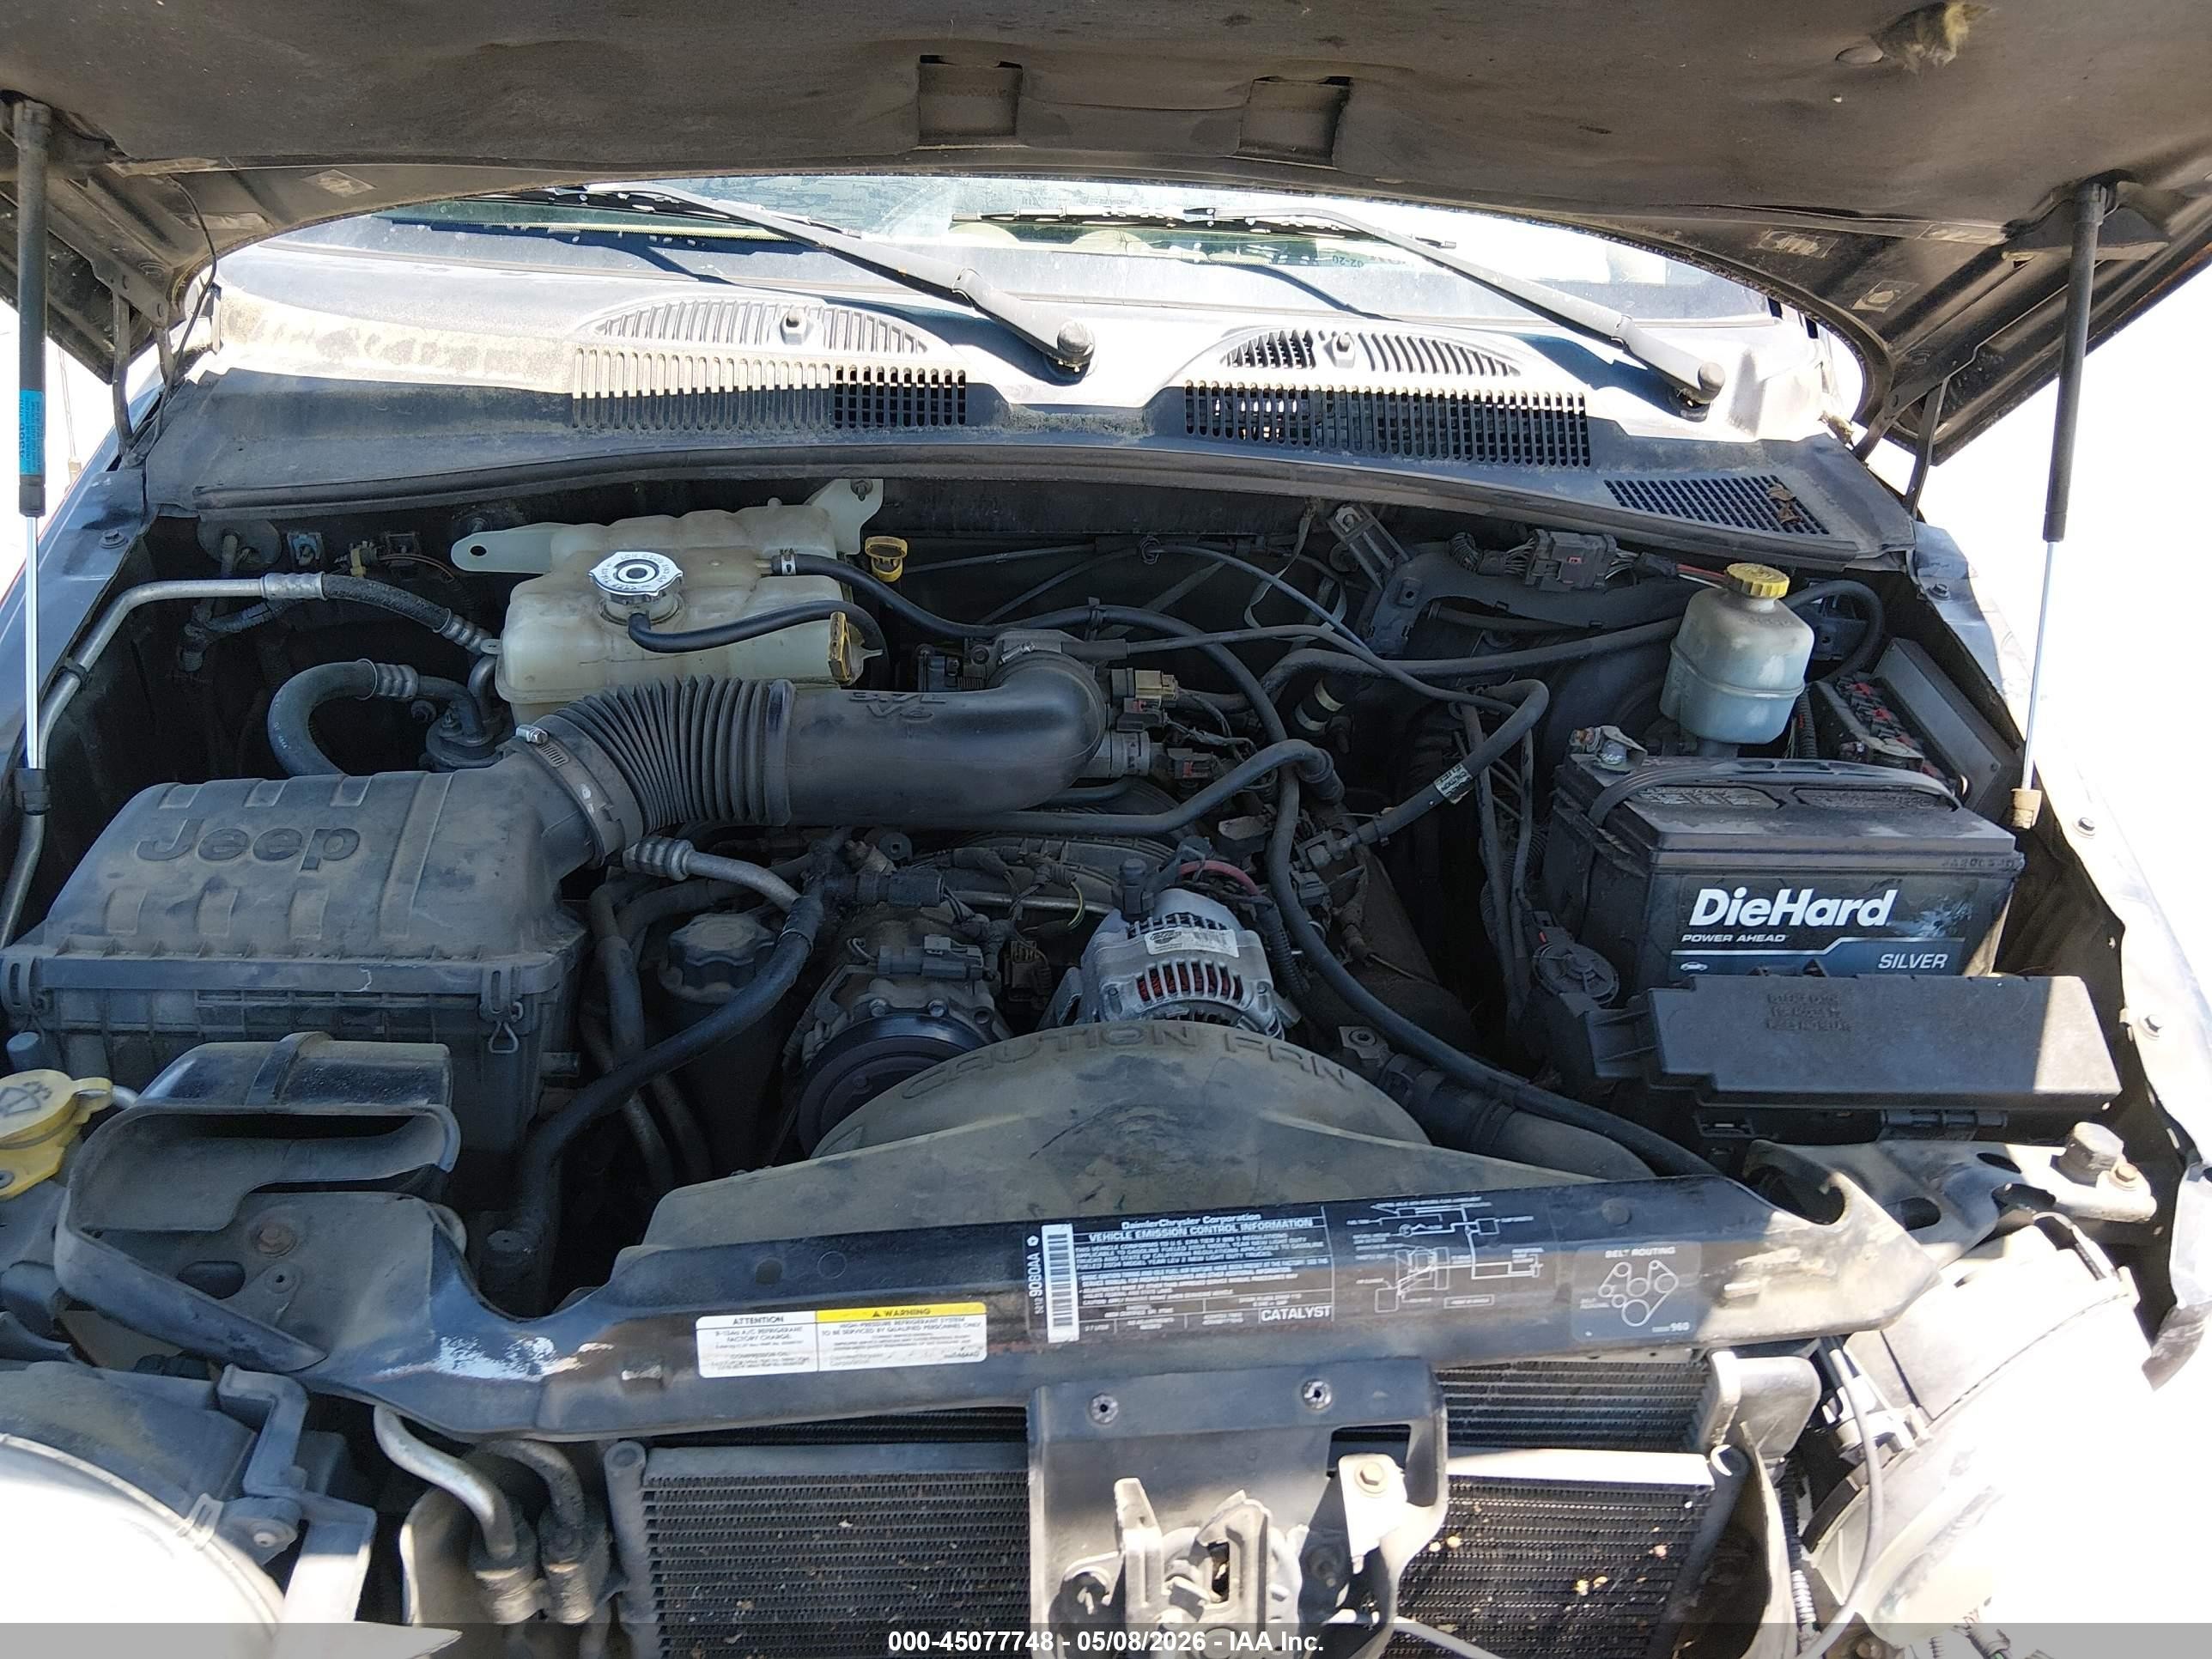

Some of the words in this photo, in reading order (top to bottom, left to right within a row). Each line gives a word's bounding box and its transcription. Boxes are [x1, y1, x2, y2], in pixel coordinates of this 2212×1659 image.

[136, 817, 361, 872] Jeep
[1689, 886, 1898, 927] DieHard
[1681, 933, 1733, 943] POWER
[1736, 933, 1786, 943] AHEAD
[1878, 953, 1948, 969] SILVER
[902, 1024, 1197, 1099] CAUTION
[1201, 1212, 1262, 1224] Corporation
[1088, 1231, 1135, 1242] VEHICLE
[1134, 1226, 1188, 1239] EMISSION
[1189, 1223, 1240, 1235] CONTROL
[1240, 1218, 1314, 1231] INFORMATION
[732, 1316, 784, 1325] ATTENTION
[885, 1308, 931, 1317] WARNING
[1261, 1304, 1332, 1322] CATALYST
